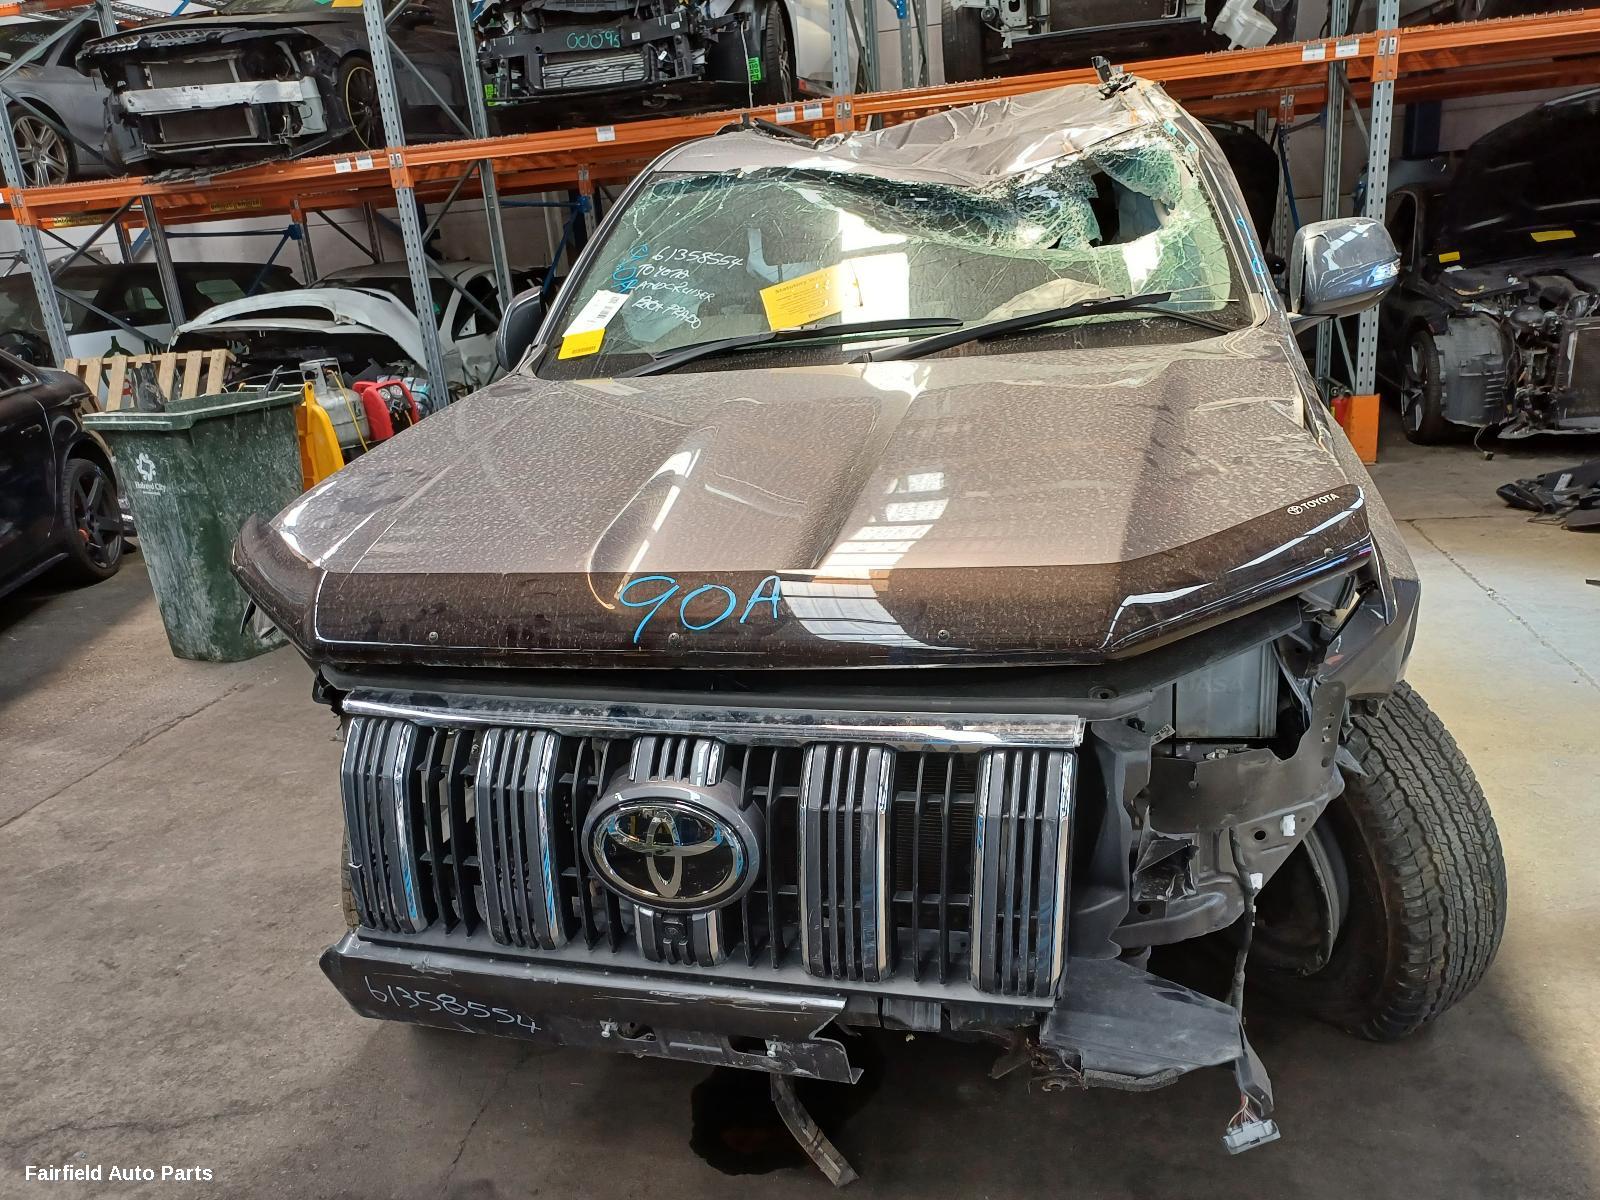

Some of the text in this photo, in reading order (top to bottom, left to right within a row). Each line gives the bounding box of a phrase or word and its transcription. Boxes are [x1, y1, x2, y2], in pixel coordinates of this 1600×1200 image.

[651, 245, 744, 270] 61358554
[1300, 492, 1340, 510] TOYOTA
[618, 575, 782, 645] 90A
[364, 975, 542, 1034] 61358554
